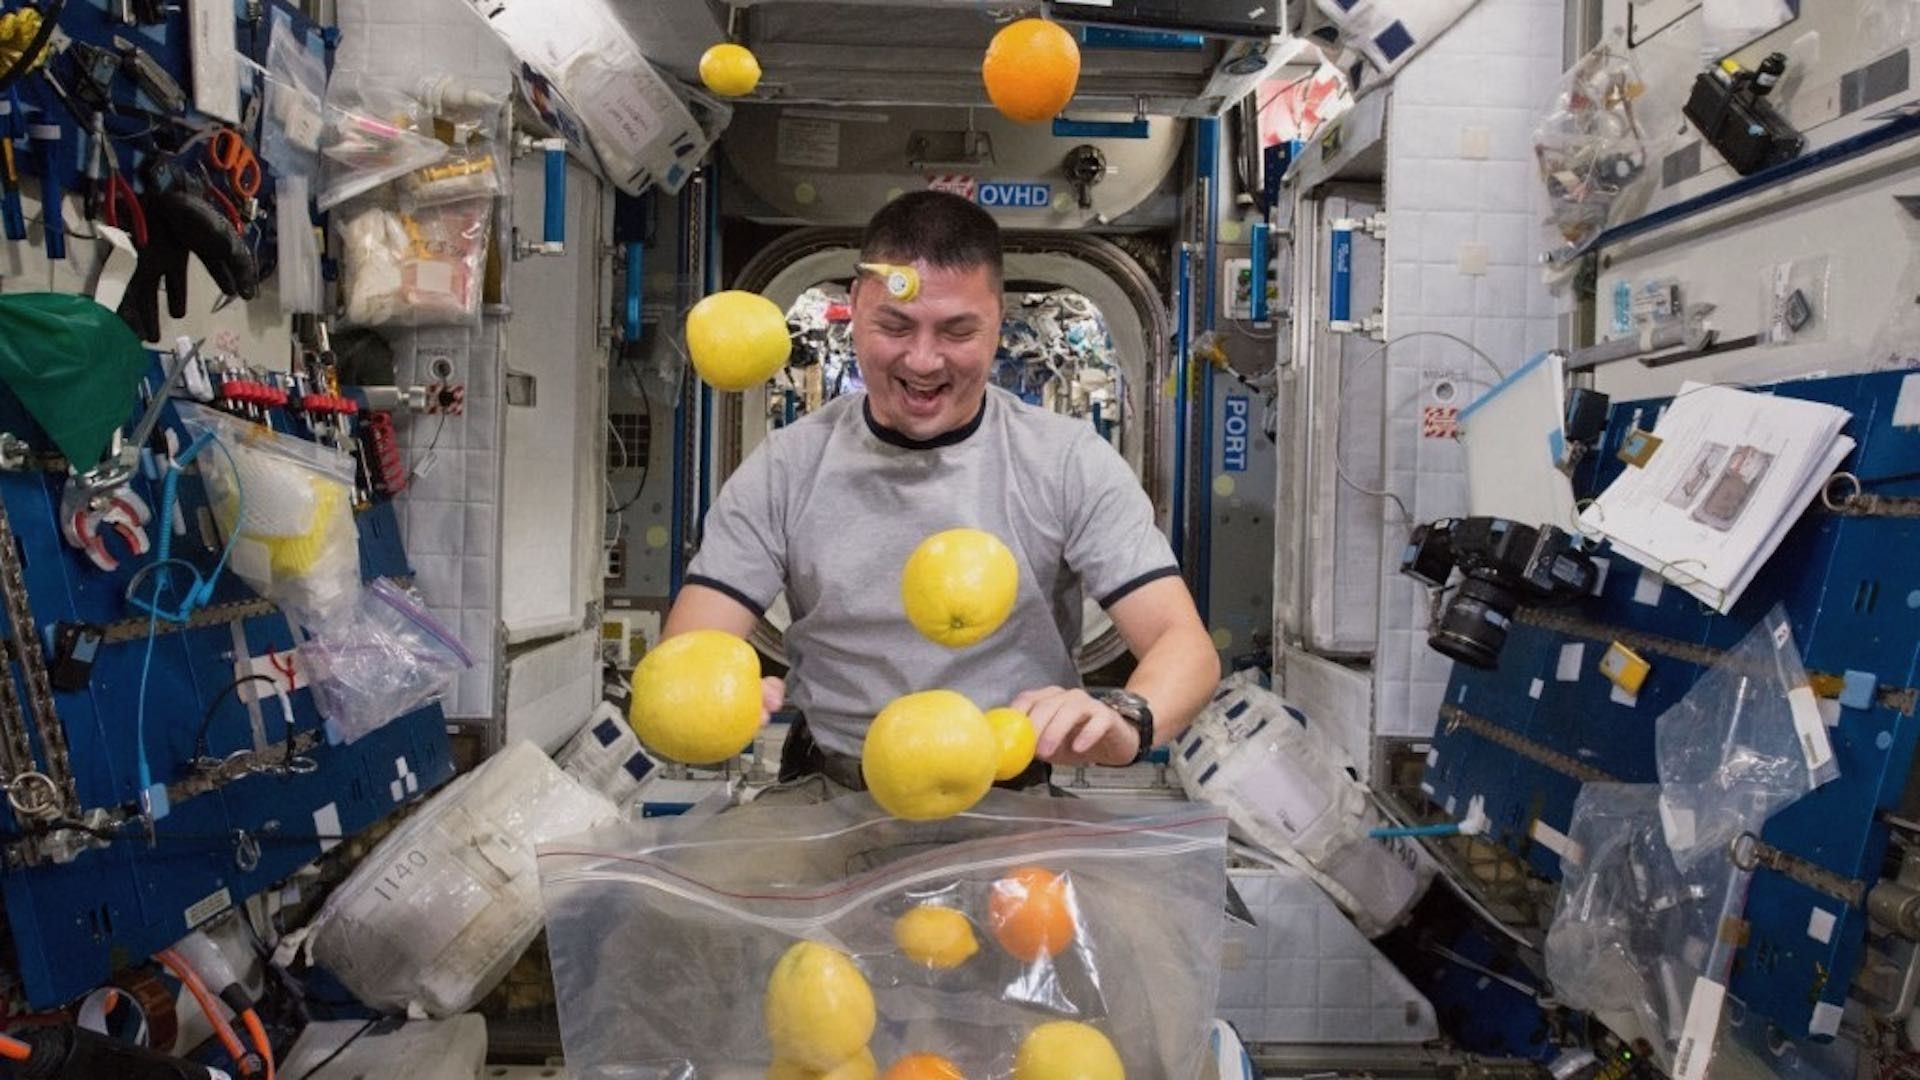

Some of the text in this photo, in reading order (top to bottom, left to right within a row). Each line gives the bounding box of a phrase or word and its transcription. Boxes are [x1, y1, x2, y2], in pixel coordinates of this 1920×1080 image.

[980, 184, 1048, 205] OVHD
[1225, 400, 1247, 470] PORT
[374, 850, 428, 901] 1140
